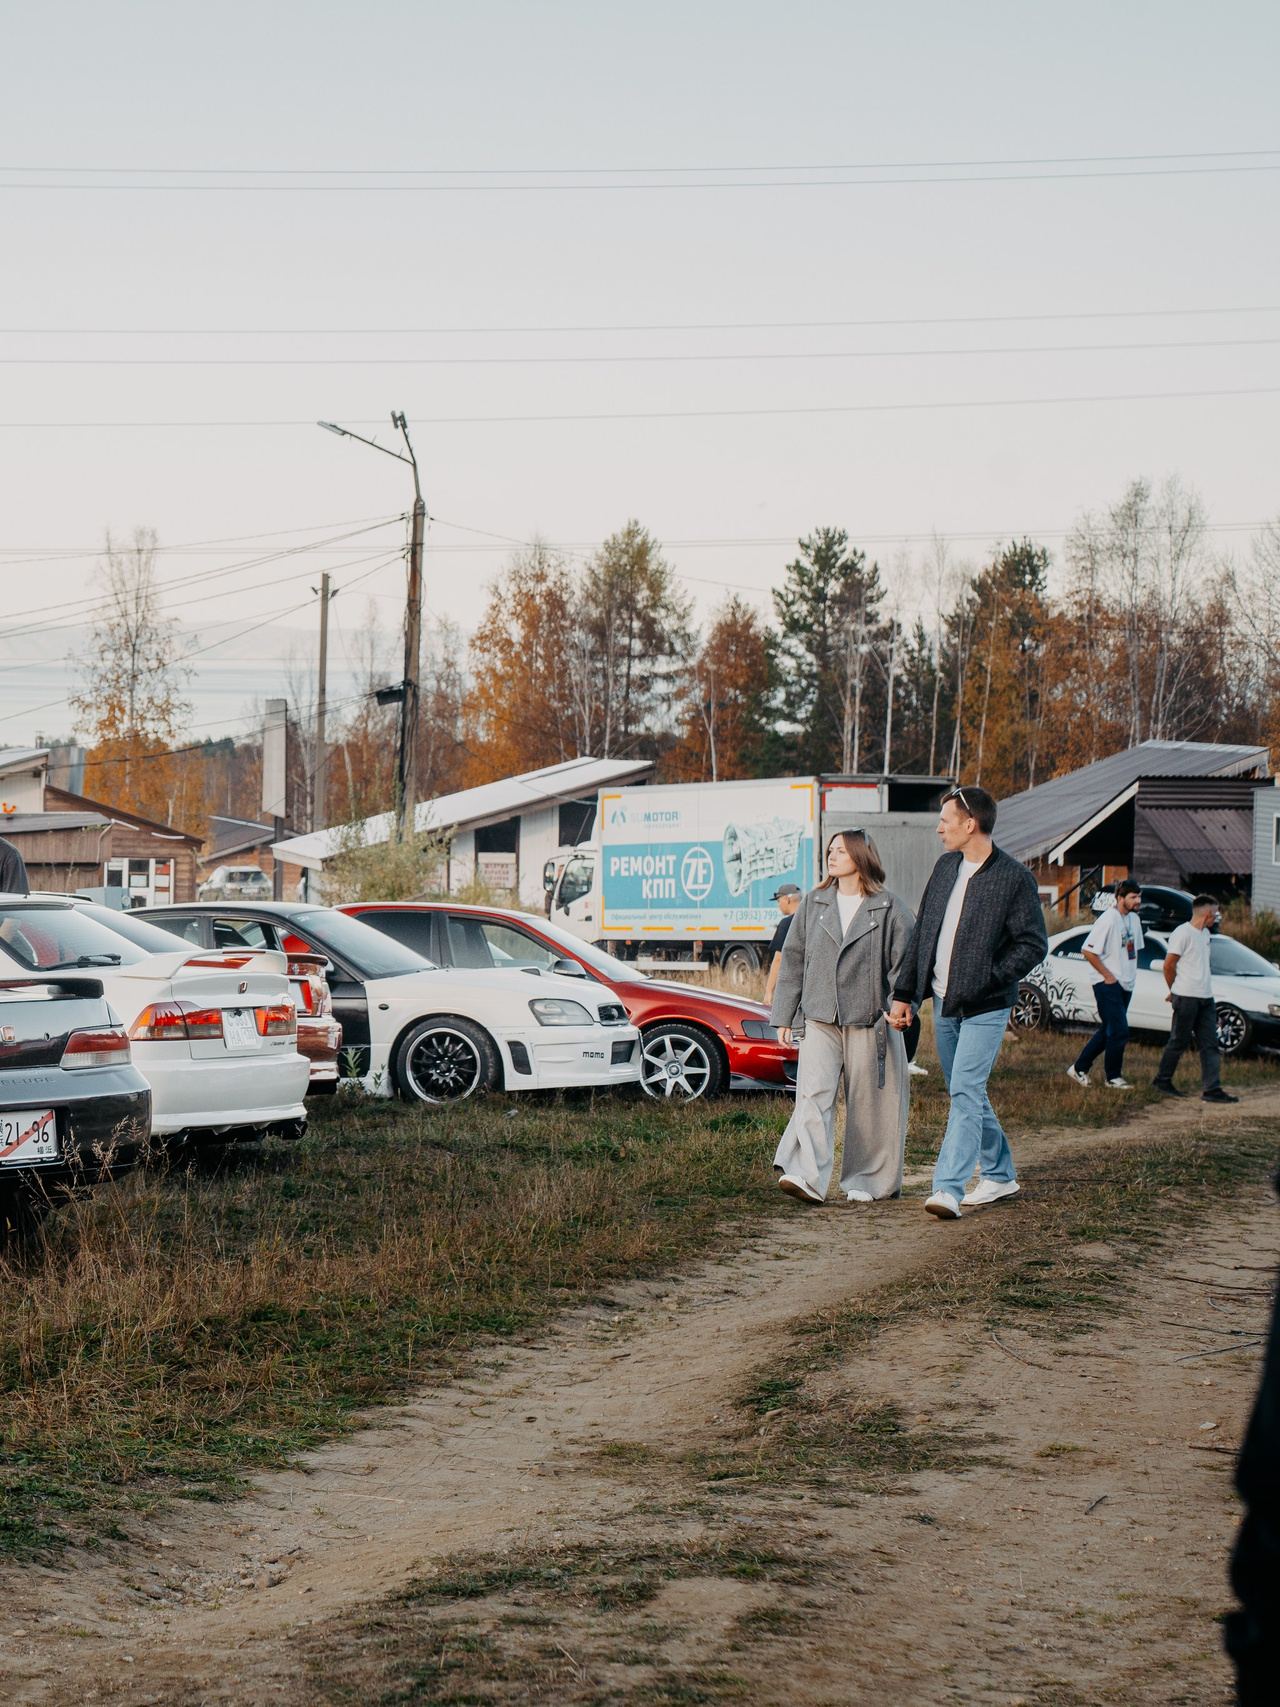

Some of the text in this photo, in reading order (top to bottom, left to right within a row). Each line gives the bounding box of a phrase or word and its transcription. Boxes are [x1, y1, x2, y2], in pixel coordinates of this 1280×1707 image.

[610, 855, 676, 877] РЕМОНТ
[642, 878, 676, 899] КПП
[723, 910, 734, 920] +7
[4, 1120, 50, 1146] 21-96
